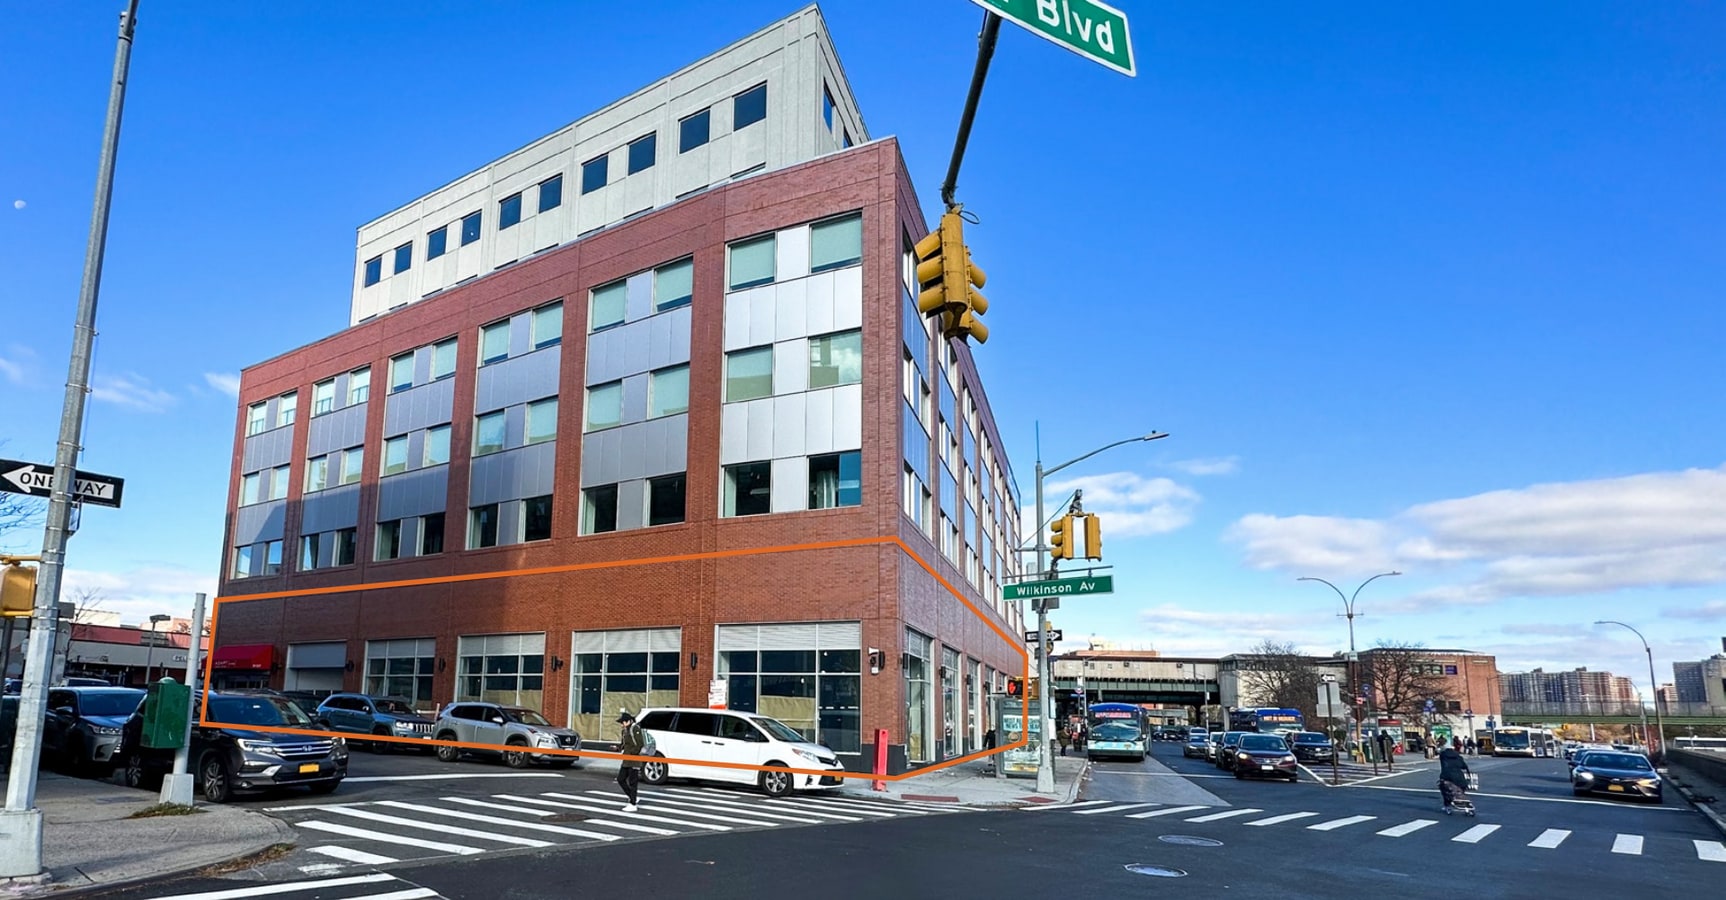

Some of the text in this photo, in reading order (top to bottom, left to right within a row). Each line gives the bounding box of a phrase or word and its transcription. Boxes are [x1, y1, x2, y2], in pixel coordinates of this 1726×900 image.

[1036, 0, 1115, 54] Blvd
[1017, 581, 1096, 596] Wilkinson Av
